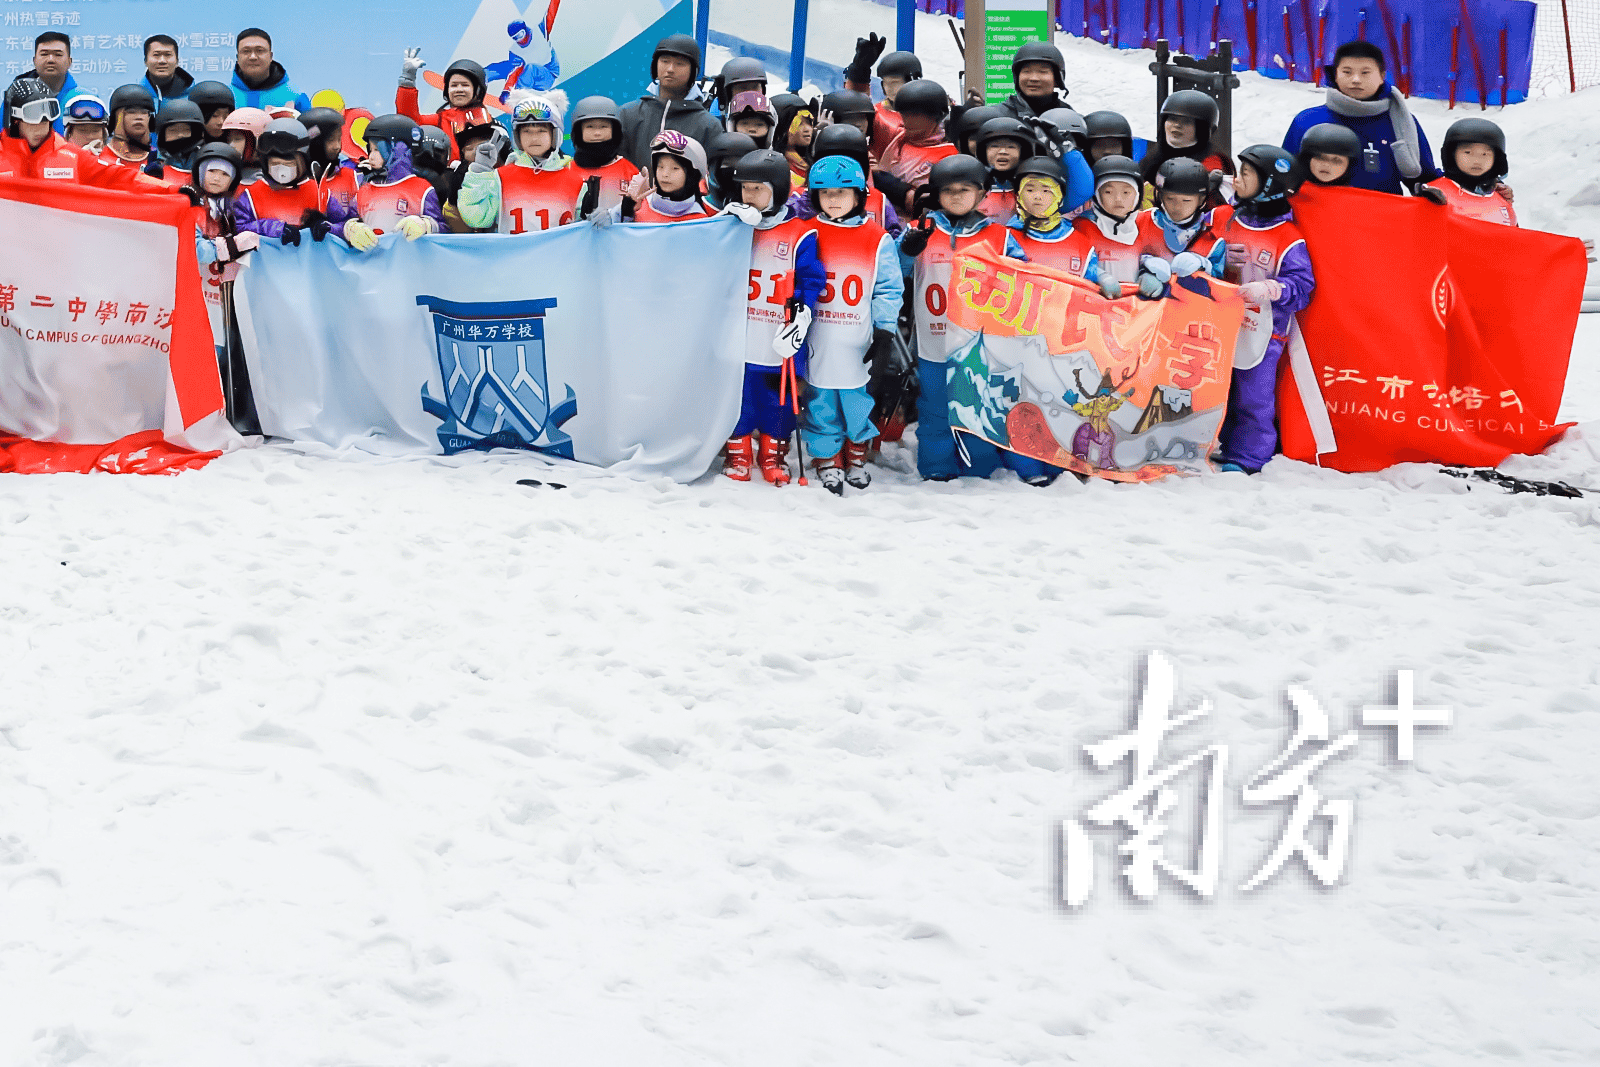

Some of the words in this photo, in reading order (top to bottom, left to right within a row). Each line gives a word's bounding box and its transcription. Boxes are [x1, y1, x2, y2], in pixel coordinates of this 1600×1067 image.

[26, 328, 79, 344] CAMPUS
[81, 333, 99, 343] OF
[101, 333, 170, 354] GUANGZHO
[442, 321, 535, 341] 广州华万学校
